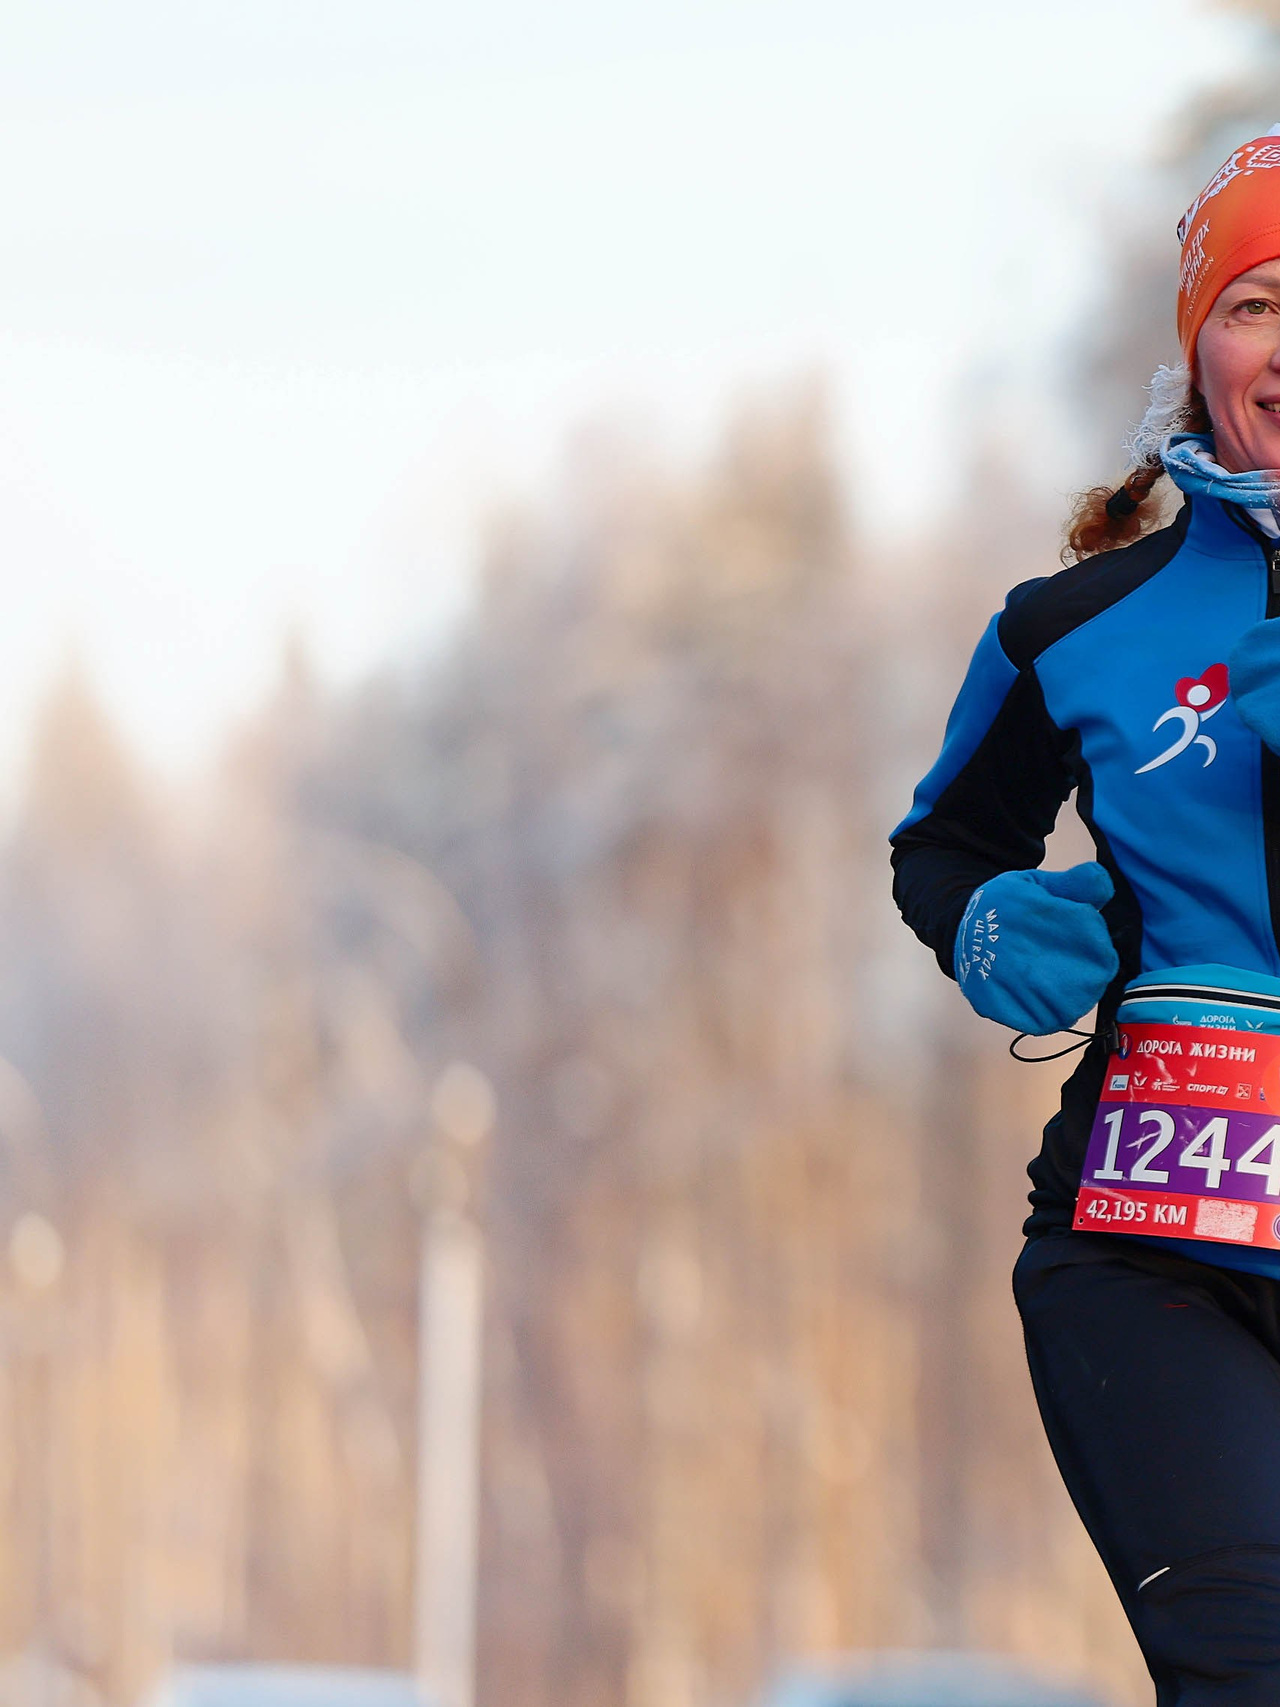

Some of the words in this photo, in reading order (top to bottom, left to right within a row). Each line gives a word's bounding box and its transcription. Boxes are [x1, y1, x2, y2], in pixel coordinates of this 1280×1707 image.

[1192, 218, 1210, 255] FOX
[985, 908, 999, 943] MAD
[972, 919, 985, 963] ULTRA
[978, 950, 996, 980] FOX
[1200, 1014, 1236, 1024] ДОРОГА
[1136, 1039, 1183, 1055] ДОРОГА
[1189, 1042, 1256, 1063] ЖИЗНИ
[1086, 1199, 1148, 1223] 42,195
